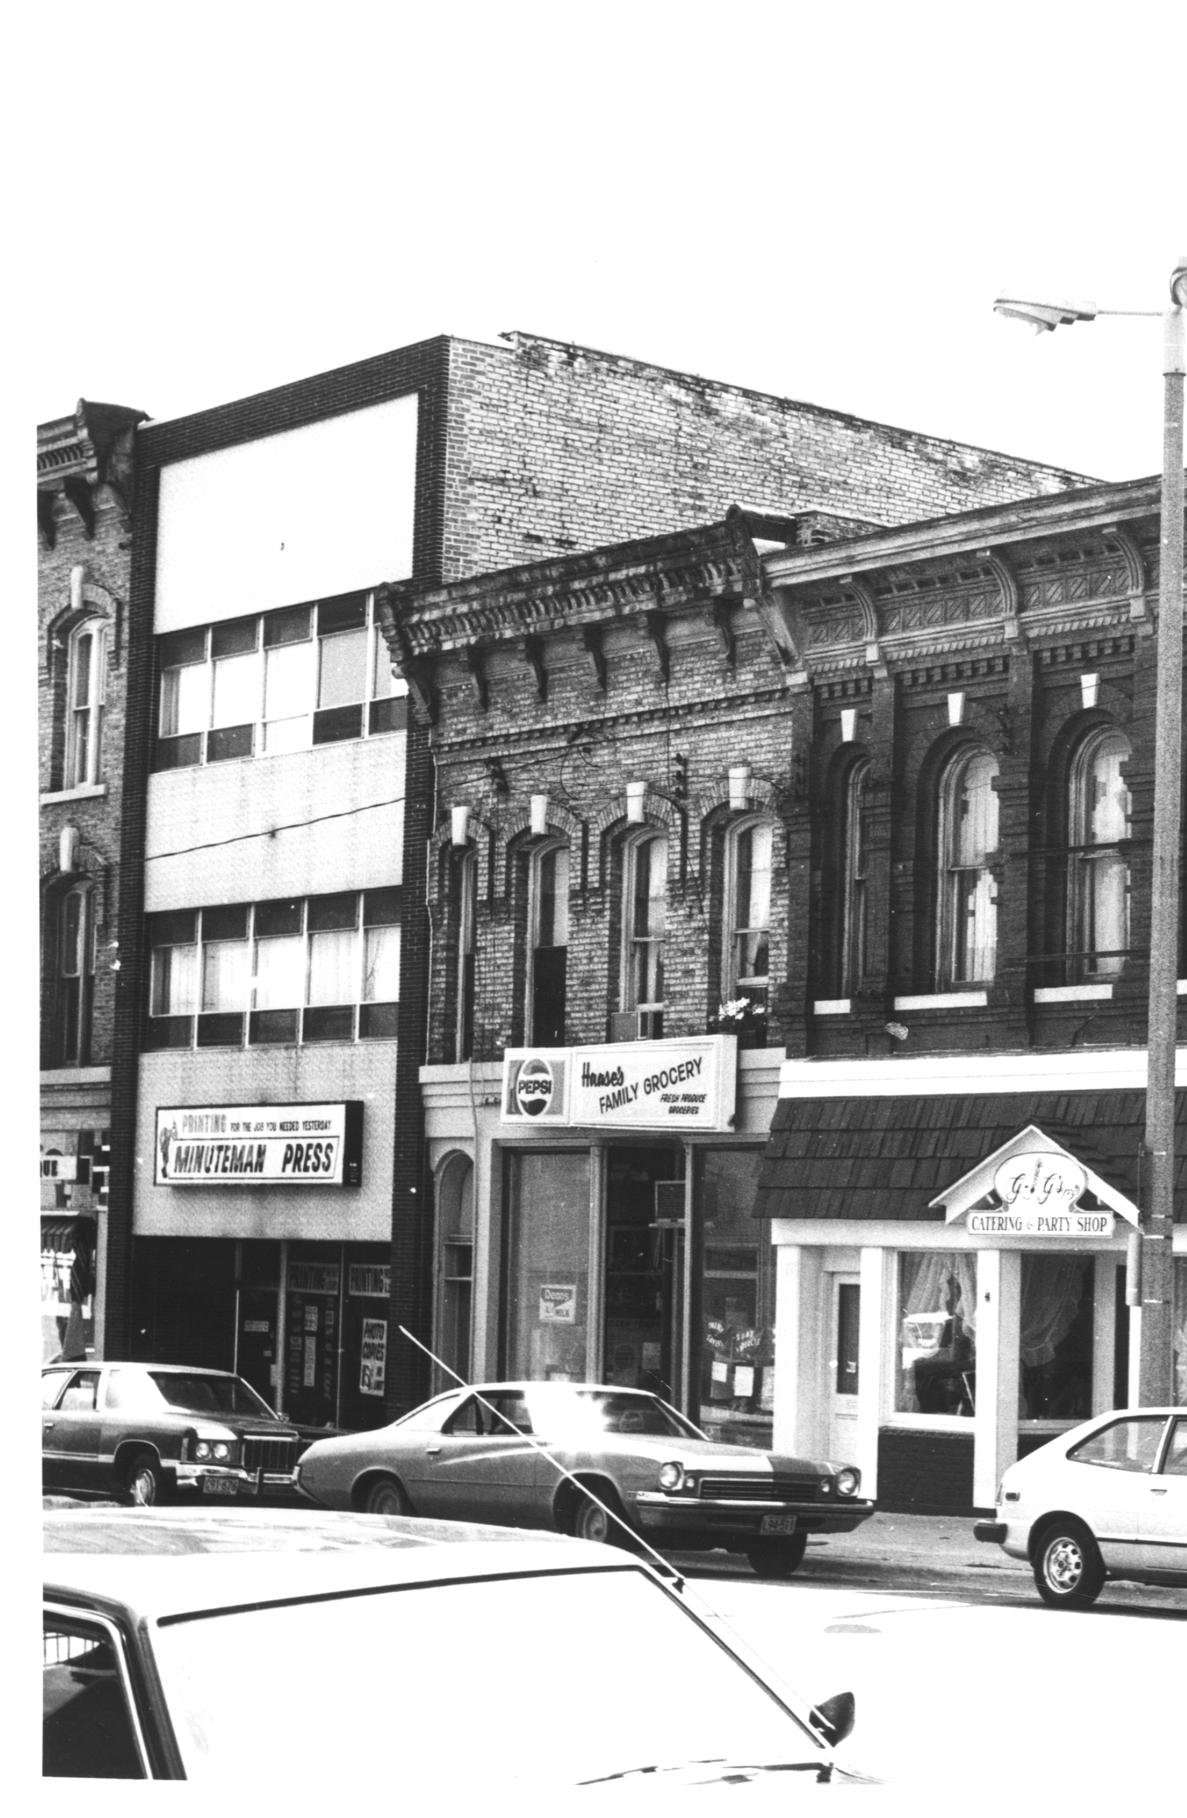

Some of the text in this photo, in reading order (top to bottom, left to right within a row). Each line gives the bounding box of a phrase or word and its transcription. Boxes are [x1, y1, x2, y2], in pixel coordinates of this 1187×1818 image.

[518, 1079, 551, 1095] PEPSI
[599, 1056, 702, 1114] FAMILY GROCERY
[660, 1093, 707, 1103] FRESH PRODUCE
[182, 1114, 332, 1133] PRINTING FOR THE JOB YOU NEEDED YESTERDAY
[174, 1142, 334, 1174] MINUTEMAN PRESS
[971, 1216, 1022, 1232] CATERING
[1037, 1216, 1072, 1232] PARTY
[1077, 1216, 1108, 1232] SHOP
